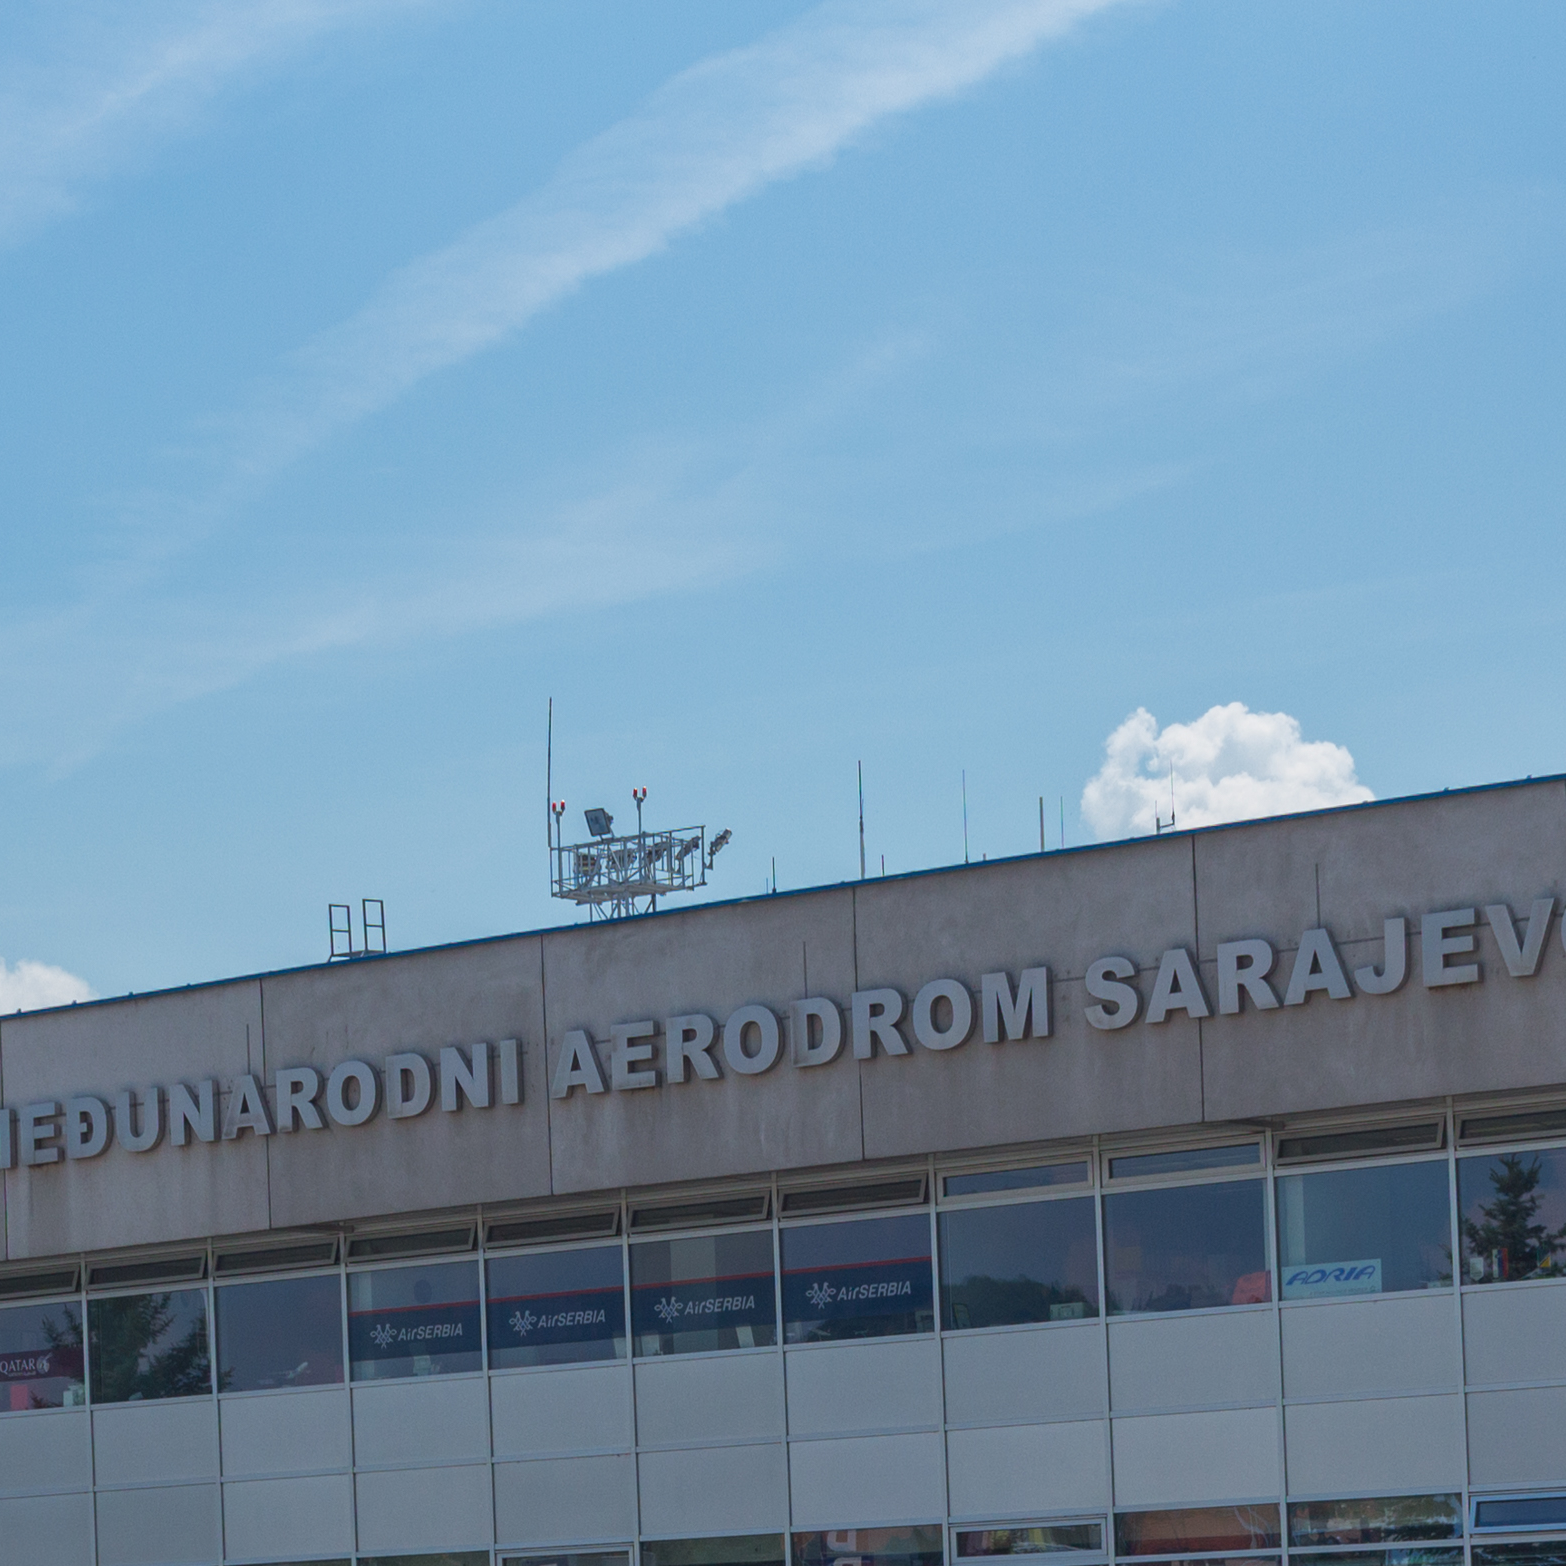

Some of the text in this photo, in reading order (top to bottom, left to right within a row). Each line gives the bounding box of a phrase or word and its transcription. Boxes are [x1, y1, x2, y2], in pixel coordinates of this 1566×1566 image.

[551, 966, 1052, 1099] AERODROM
[1285, 1265, 1376, 1286] ADRIA
[837, 1281, 912, 1301] AirSERBIA
[684, 1295, 755, 1315] AirSERBIA
[537, 1308, 606, 1330] AirSERBIA
[397, 1323, 463, 1341] AirSERBIA
[0, 1358, 36, 1375] QATAR
